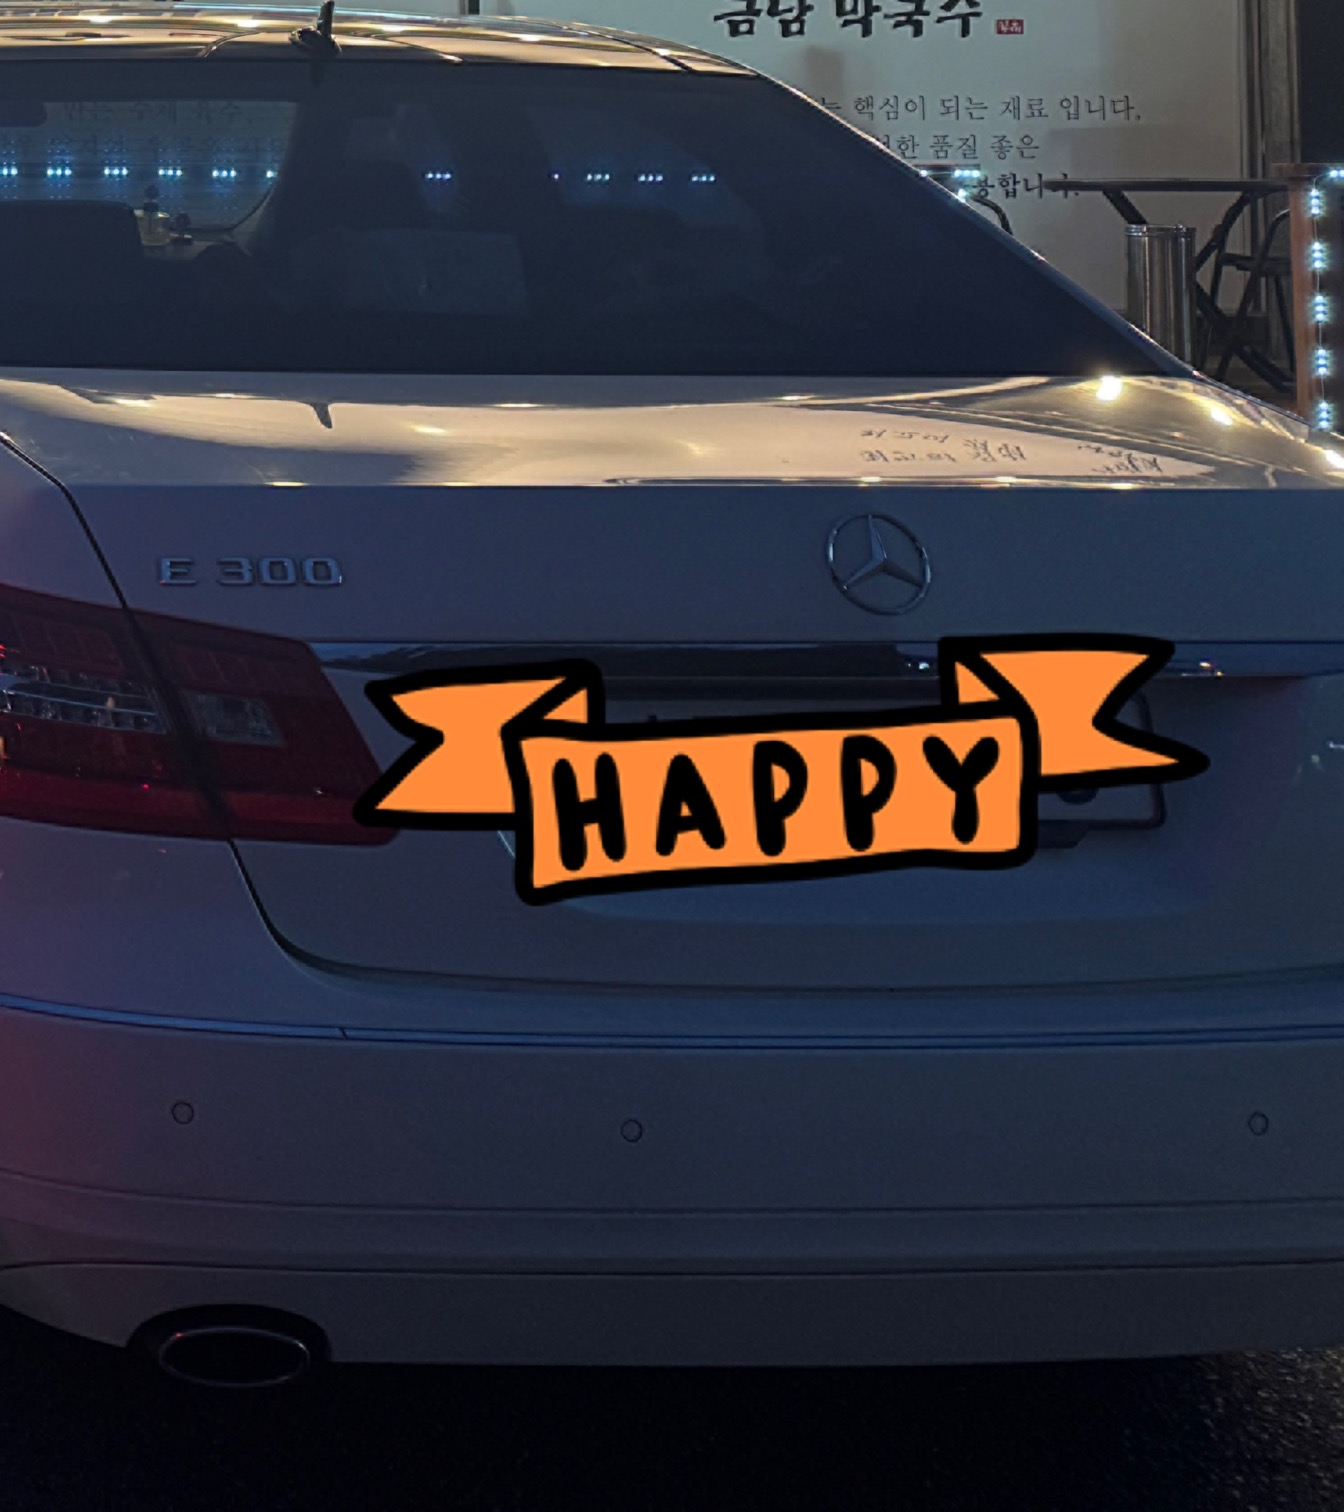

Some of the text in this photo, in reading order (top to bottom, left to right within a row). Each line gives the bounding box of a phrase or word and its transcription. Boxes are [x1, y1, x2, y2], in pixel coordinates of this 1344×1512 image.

[854, 94, 925, 121] 핵심이
[940, 94, 989, 121] 되는
[1000, 94, 1049, 122] 재료
[930, 134, 978, 160] 품질
[990, 134, 1041, 160] 좋은
[160, 556, 343, 586] E 300
